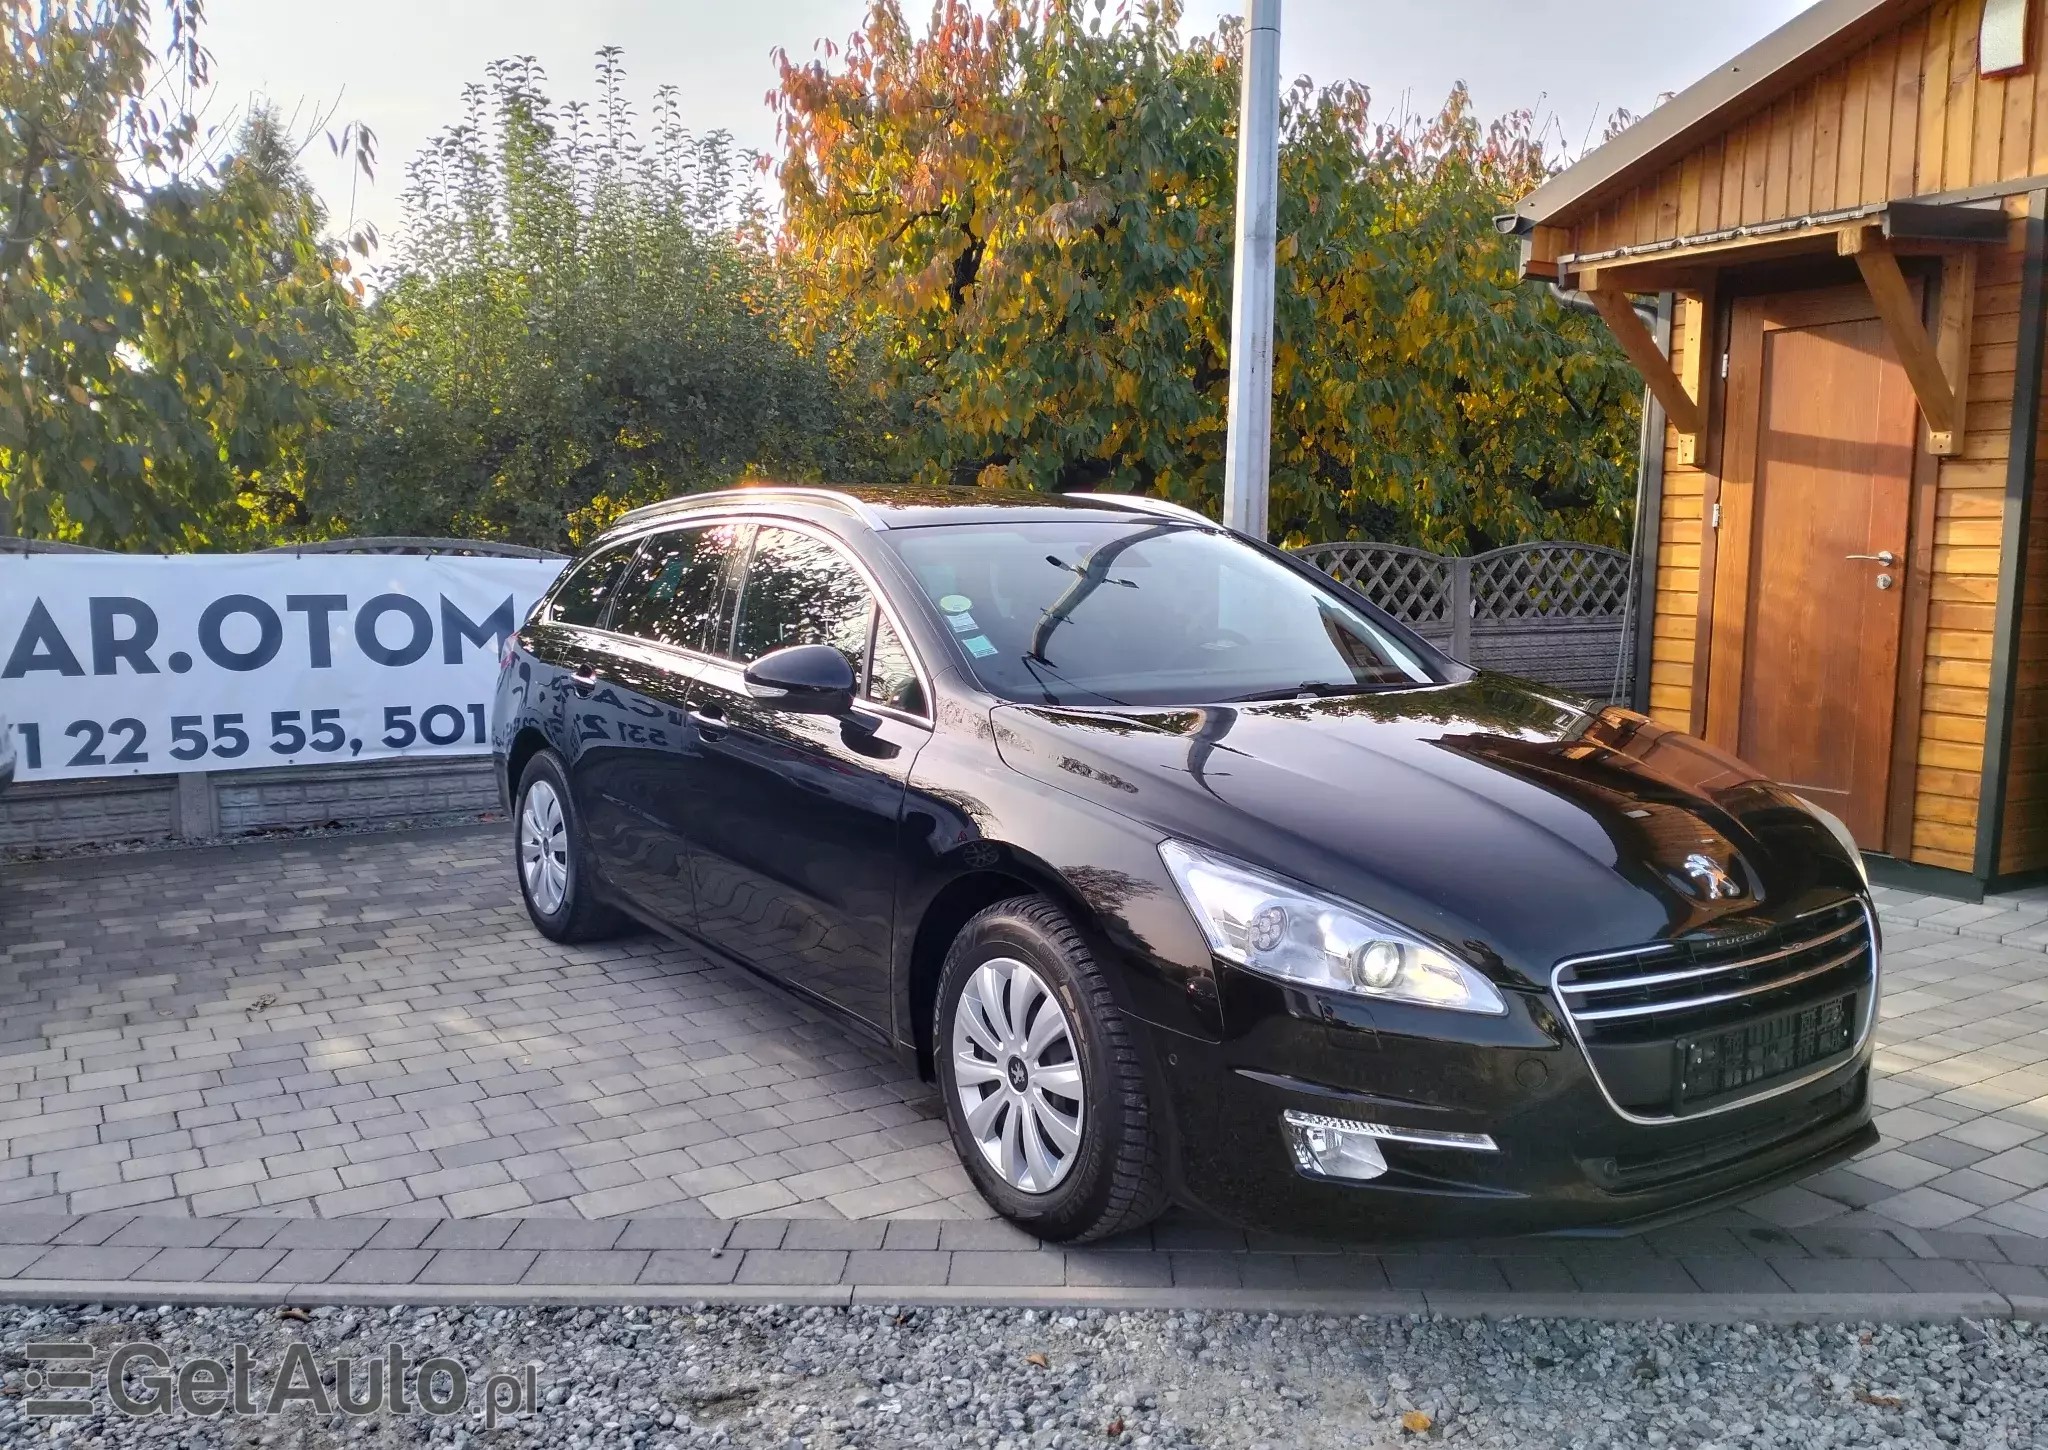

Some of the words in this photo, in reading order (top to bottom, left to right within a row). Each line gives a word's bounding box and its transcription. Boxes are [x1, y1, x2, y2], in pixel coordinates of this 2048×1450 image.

[65, 717, 149, 767] 22
[168, 712, 250, 761] 55
[269, 708, 363, 757] 55,
[380, 703, 486, 749] 501
[1705, 930, 1768, 949] PEUGEOT
